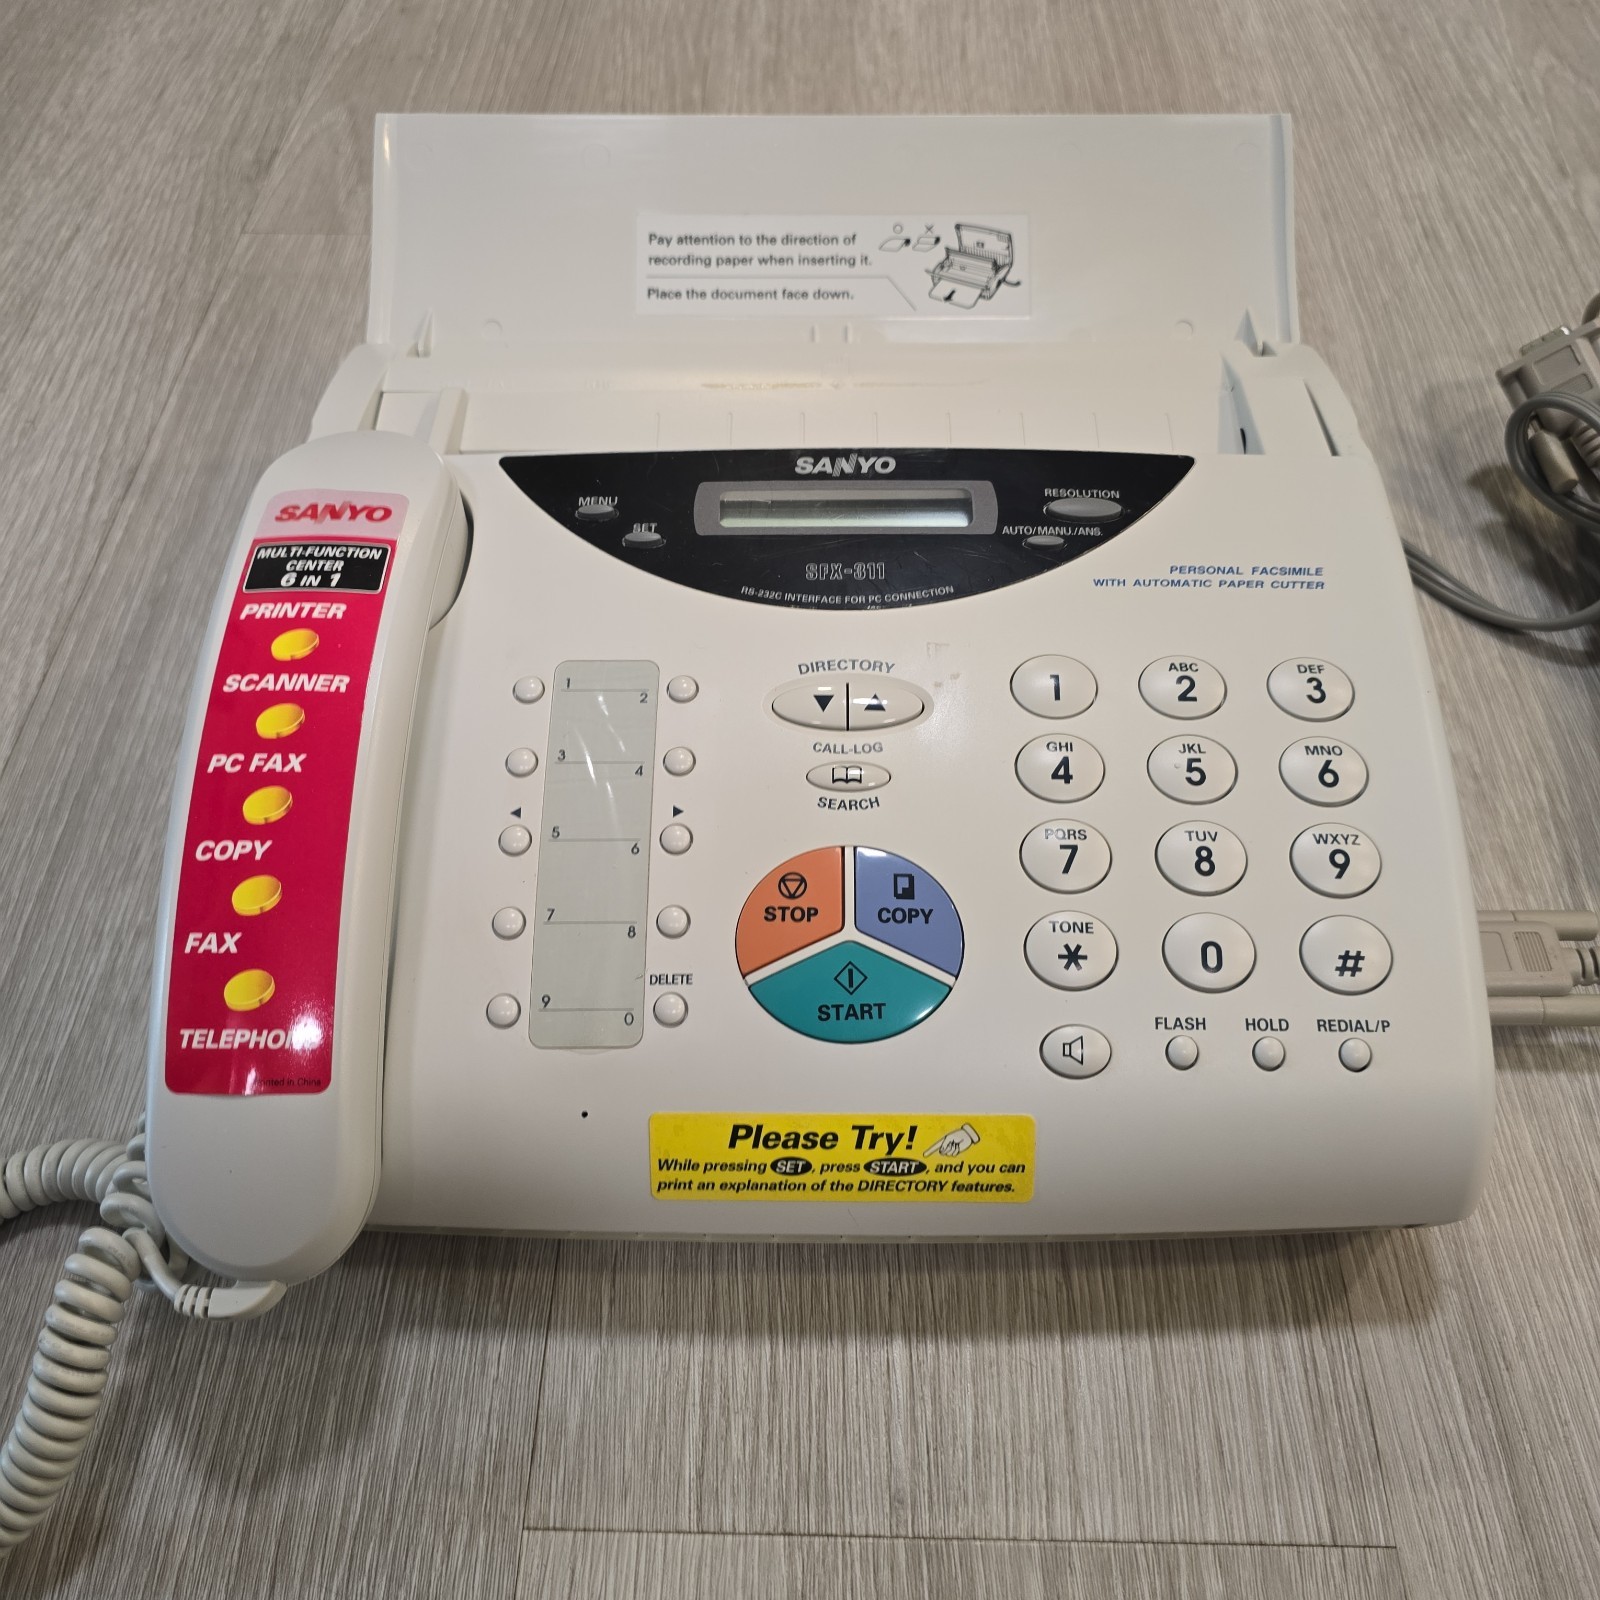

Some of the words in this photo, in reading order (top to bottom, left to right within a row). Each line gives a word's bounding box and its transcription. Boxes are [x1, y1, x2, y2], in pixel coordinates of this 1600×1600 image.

[648, 232, 672, 248] Pay
[676, 233, 735, 246] attention
[739, 234, 752, 246] to
[756, 233, 777, 246] the
[781, 233, 838, 246] direction
[843, 233, 857, 246] of
[649, 254, 712, 268] recording
[716, 256, 753, 268] paper
[758, 254, 794, 266] when
[798, 254, 856, 268] inserting
[860, 255, 872, 266] it.
[648, 288, 682, 300] Place
[686, 288, 706, 300] the
[711, 288, 778, 300] document
[782, 288, 809, 300] face
[813, 288, 854, 300] down.
[795, 453, 896, 477] SANYO
[1044, 488, 1120, 499] RESOLUTION
[578, 496, 618, 507] MENU
[275, 501, 393, 525] SANYO
[632, 522, 658, 534] SET
[257, 546, 383, 561] MULTI-FUNCTION
[286, 560, 344, 572] CENTER
[806, 562, 885, 580] SFX-311
[1170, 565, 1244, 576] PERSONAL
[1251, 566, 1324, 577] FACSIMILE
[280, 573, 296, 587] 6
[300, 576, 320, 587] IN
[330, 573, 342, 587] 1
[1093, 578, 1126, 587] WITH
[1133, 578, 1213, 588] AUTOMATIC
[1218, 579, 1264, 589] PAPER
[1270, 580, 1325, 590] CUTTER
[740, 586, 782, 600] RS-232C
[784, 592, 842, 604] INTERFACE
[845, 594, 866, 604] FOR
[869, 594, 882, 604] PC
[884, 585, 954, 602] CONNECTION
[239, 602, 348, 620] PRINTER
[798, 659, 895, 675] DIRECTORY
[1168, 662, 1199, 673] ABC
[1297, 664, 1326, 675] DEF
[222, 673, 350, 693] SCANNER
[566, 678, 571, 689] 1
[1050, 674, 1061, 701] 1
[1175, 675, 1198, 702] 2
[1306, 677, 1327, 704] 3
[640, 692, 648, 704] 2
[813, 742, 884, 755] CALL-LOG
[1046, 741, 1074, 752] GHI
[1178, 743, 1206, 754] JKL
[1304, 745, 1344, 757] MNO
[558, 749, 566, 762] 3
[207, 754, 244, 774] PC
[248, 753, 307, 773] FAX
[634, 764, 644, 777] 4
[1050, 756, 1074, 784] 4
[1185, 758, 1206, 786] 5
[1318, 760, 1340, 788] 6
[818, 796, 880, 811] SEARCH
[552, 826, 560, 839] 5
[1044, 828, 1088, 841] PQRS
[1184, 830, 1218, 842] TUV
[1312, 832, 1362, 846] WXYZ
[195, 840, 272, 862] COPY
[630, 842, 640, 856] 6
[1059, 844, 1078, 874] 7
[1194, 846, 1216, 877] 8
[1328, 848, 1350, 880] 9
[546, 908, 556, 921] 7
[764, 906, 819, 922] STOP
[878, 907, 934, 924] COPY
[628, 926, 636, 939] 8
[1048, 920, 1094, 934] TONE
[184, 932, 242, 954] FAX
[1200, 940, 1224, 974] 0
[1334, 950, 1366, 978] #
[650, 974, 694, 986] DELETE
[542, 994, 551, 1008] 9
[624, 1012, 634, 1026] 0
[818, 1002, 886, 1022] START
[1154, 1017, 1206, 1031] FLASH
[1245, 1018, 1290, 1032] HOLD
[1316, 1018, 1391, 1033] REDIAL/P
[180, 1028, 322, 1050] TELEPHO
[287, 1078, 294, 1086] in
[298, 1078, 321, 1086] China
[728, 1124, 839, 1150] Please
[852, 1125, 918, 1156] Try!
[658, 1158, 700, 1172] While
[703, 1159, 768, 1175] pressing
[820, 1163, 860, 1174] press
[934, 1161, 964, 1174] and
[968, 1163, 995, 1176] you
[999, 1164, 1026, 1174] can
[657, 1178, 693, 1192] print
[697, 1181, 715, 1190] an
[720, 1179, 807, 1193] explanation
[811, 1180, 827, 1191] of
[830, 1180, 854, 1192] the
[858, 1180, 948, 1192] DIRECTORY
[951, 1180, 1015, 1192] features.
